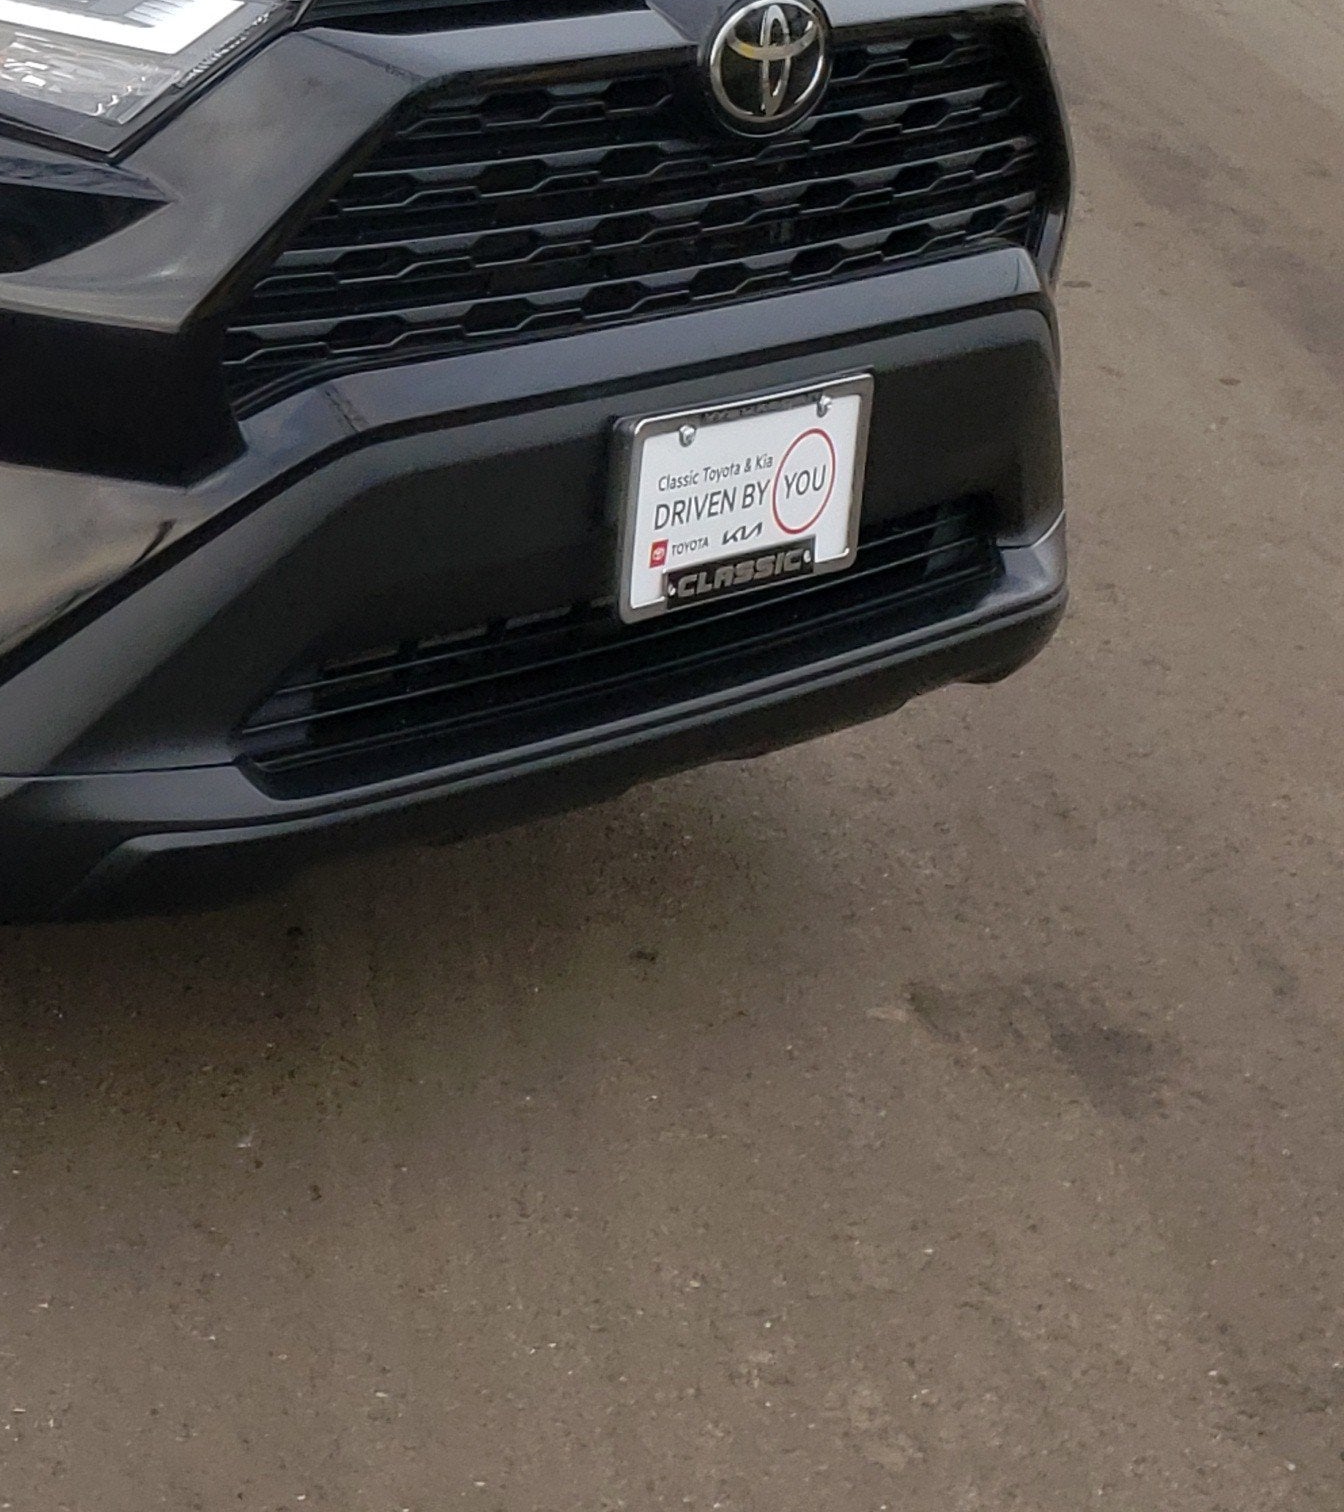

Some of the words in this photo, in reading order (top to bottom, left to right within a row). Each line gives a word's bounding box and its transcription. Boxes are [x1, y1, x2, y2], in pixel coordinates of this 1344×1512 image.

[658, 471, 699, 492] Classic
[703, 462, 741, 484] Toyota
[744, 461, 752, 473] &
[755, 453, 774, 468] Kia
[653, 486, 736, 530] DRIVEN
[742, 479, 770, 508] BY
[784, 465, 826, 499] YOU
[671, 537, 709, 556] TOYOTA
[677, 550, 802, 597] CLASSIC
